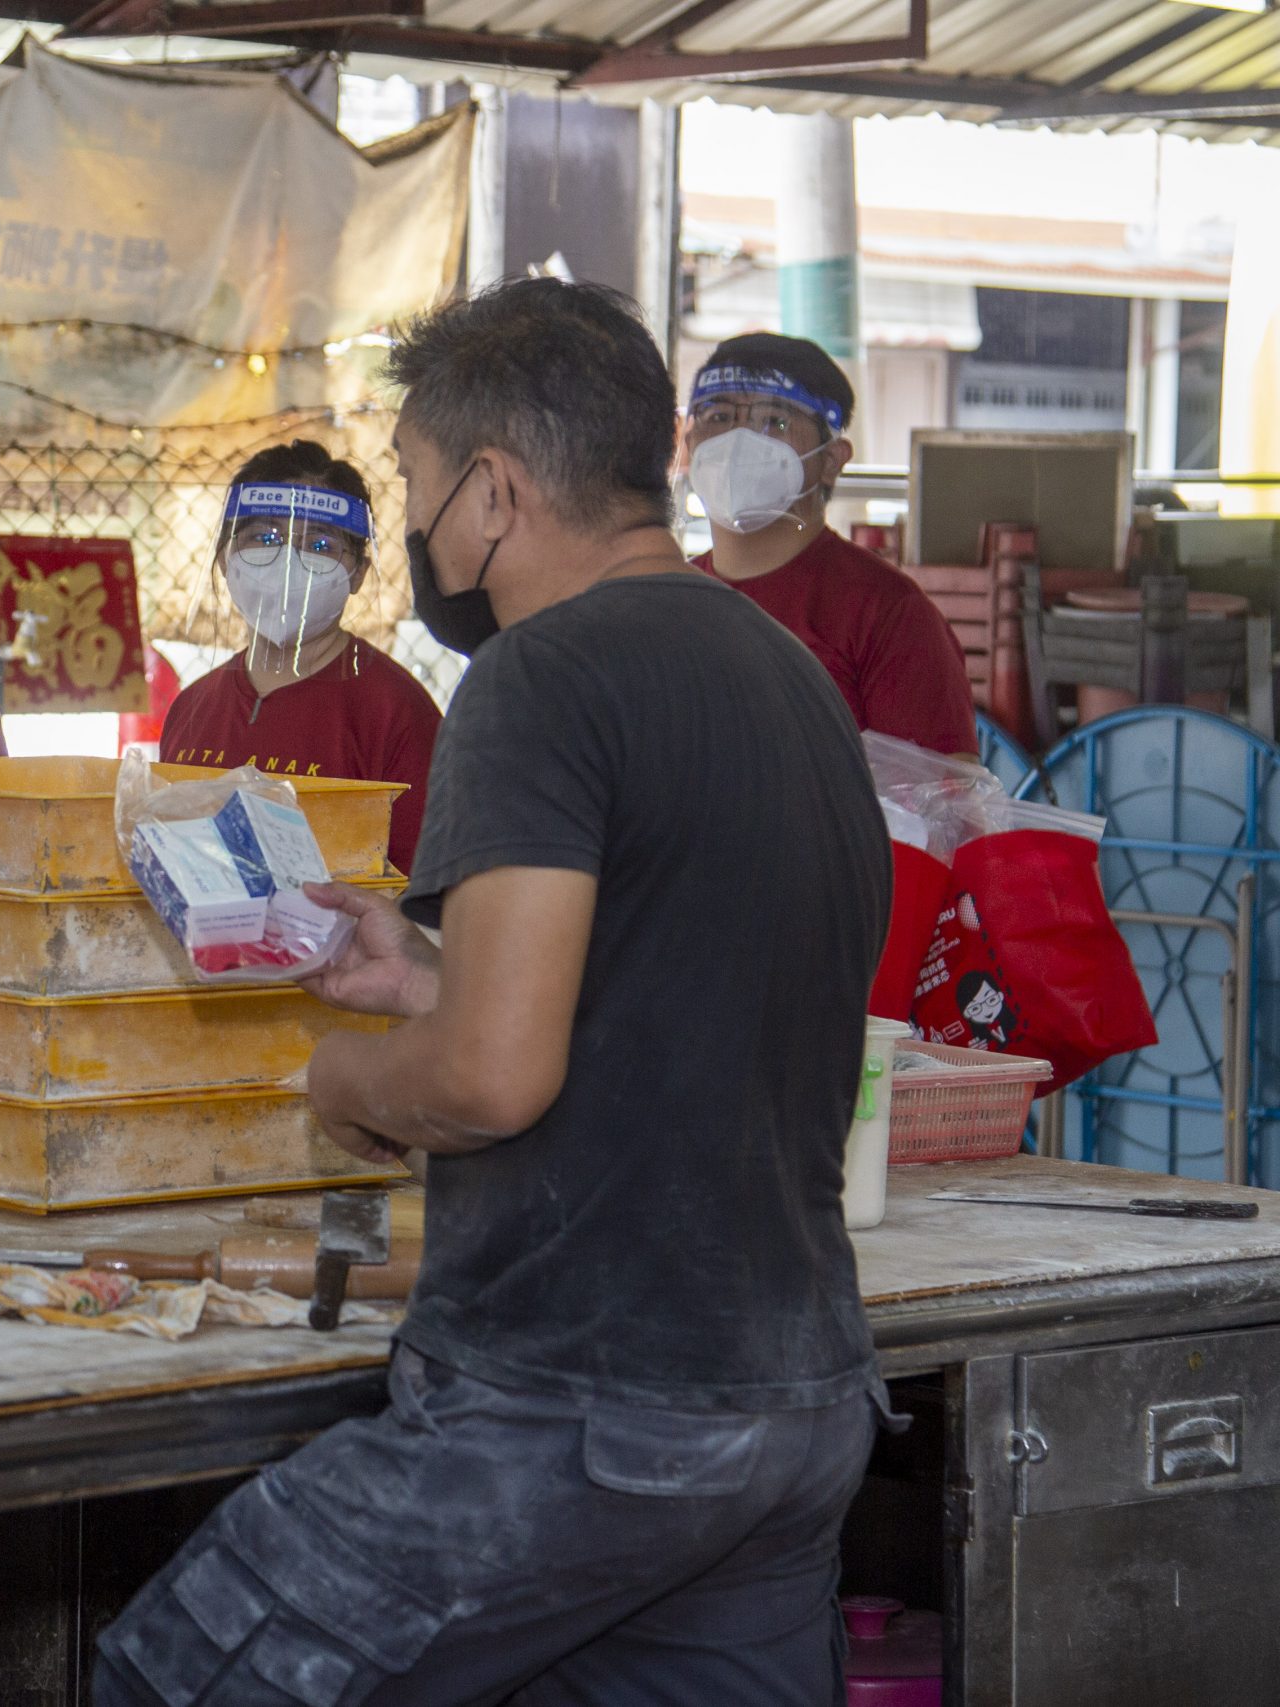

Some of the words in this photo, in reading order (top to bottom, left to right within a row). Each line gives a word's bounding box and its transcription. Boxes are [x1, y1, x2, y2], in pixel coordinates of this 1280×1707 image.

[705, 371, 733, 383] Fae
[249, 489, 283, 502] Face
[289, 491, 341, 511] Shield
[271, 508, 295, 516] Splas
[176, 749, 224, 764] KITA
[246, 754, 321, 777] ANAK
